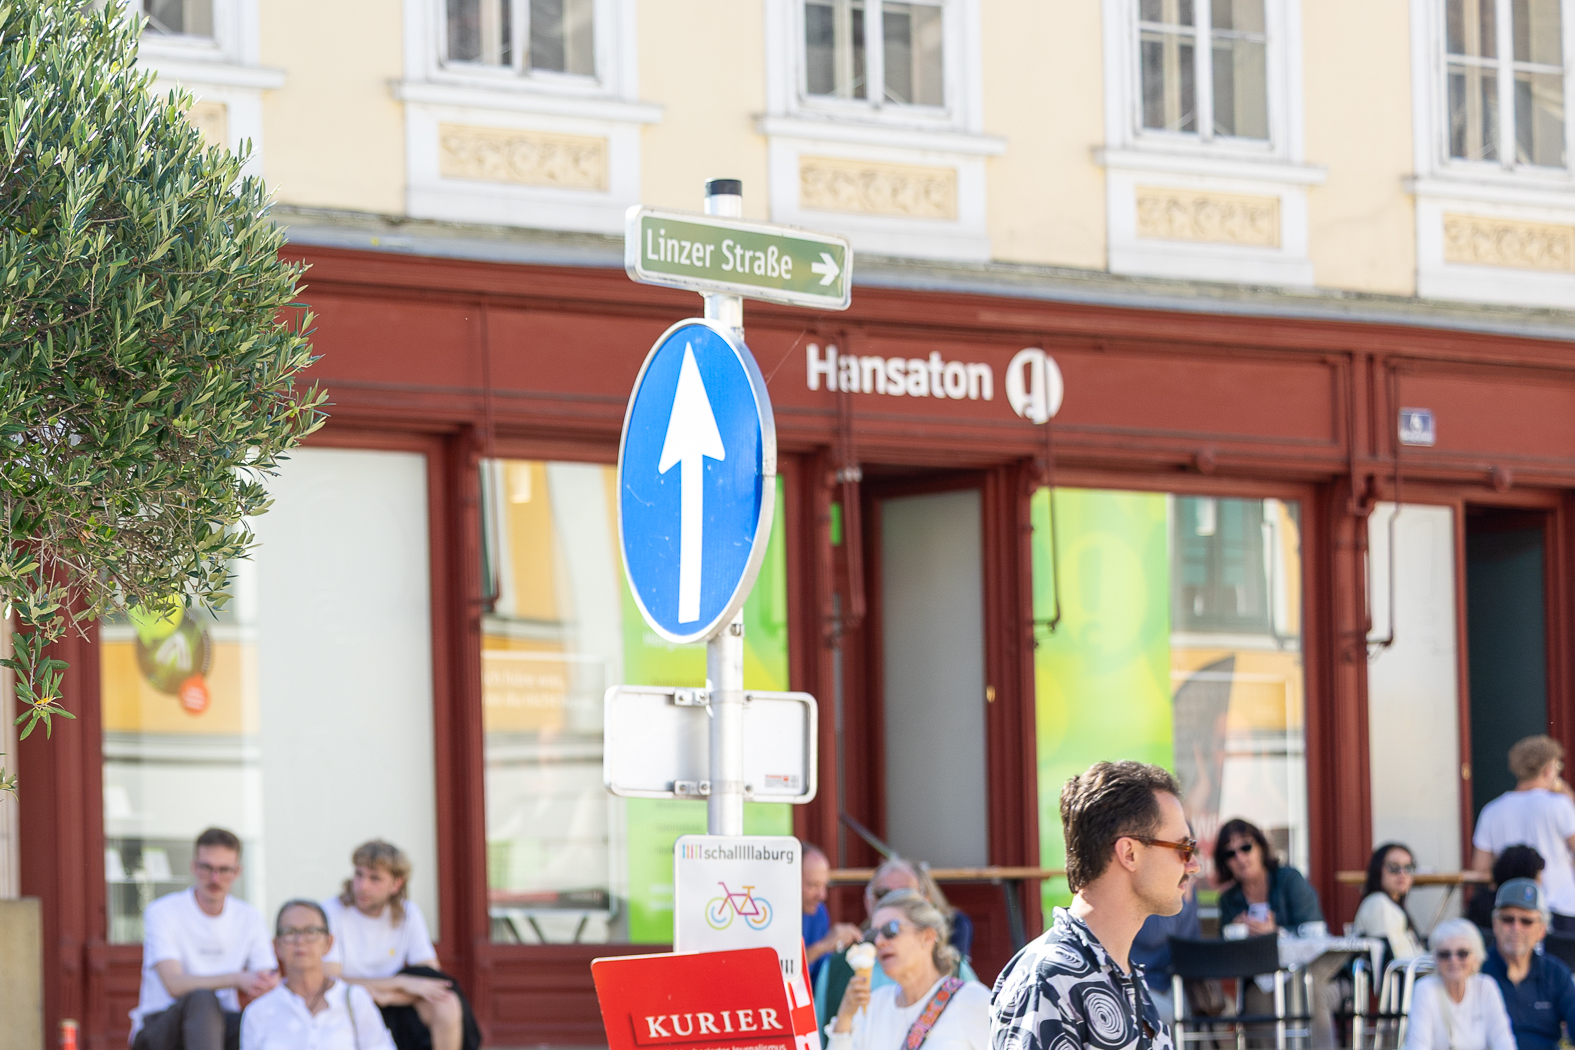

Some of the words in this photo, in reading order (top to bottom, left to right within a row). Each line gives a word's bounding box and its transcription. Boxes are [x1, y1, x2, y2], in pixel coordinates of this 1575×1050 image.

[647, 228, 715, 268] Linzer
[721, 239, 793, 280] Straße
[806, 343, 994, 401] Hansaton
[645, 1008, 784, 1038] KURIER
